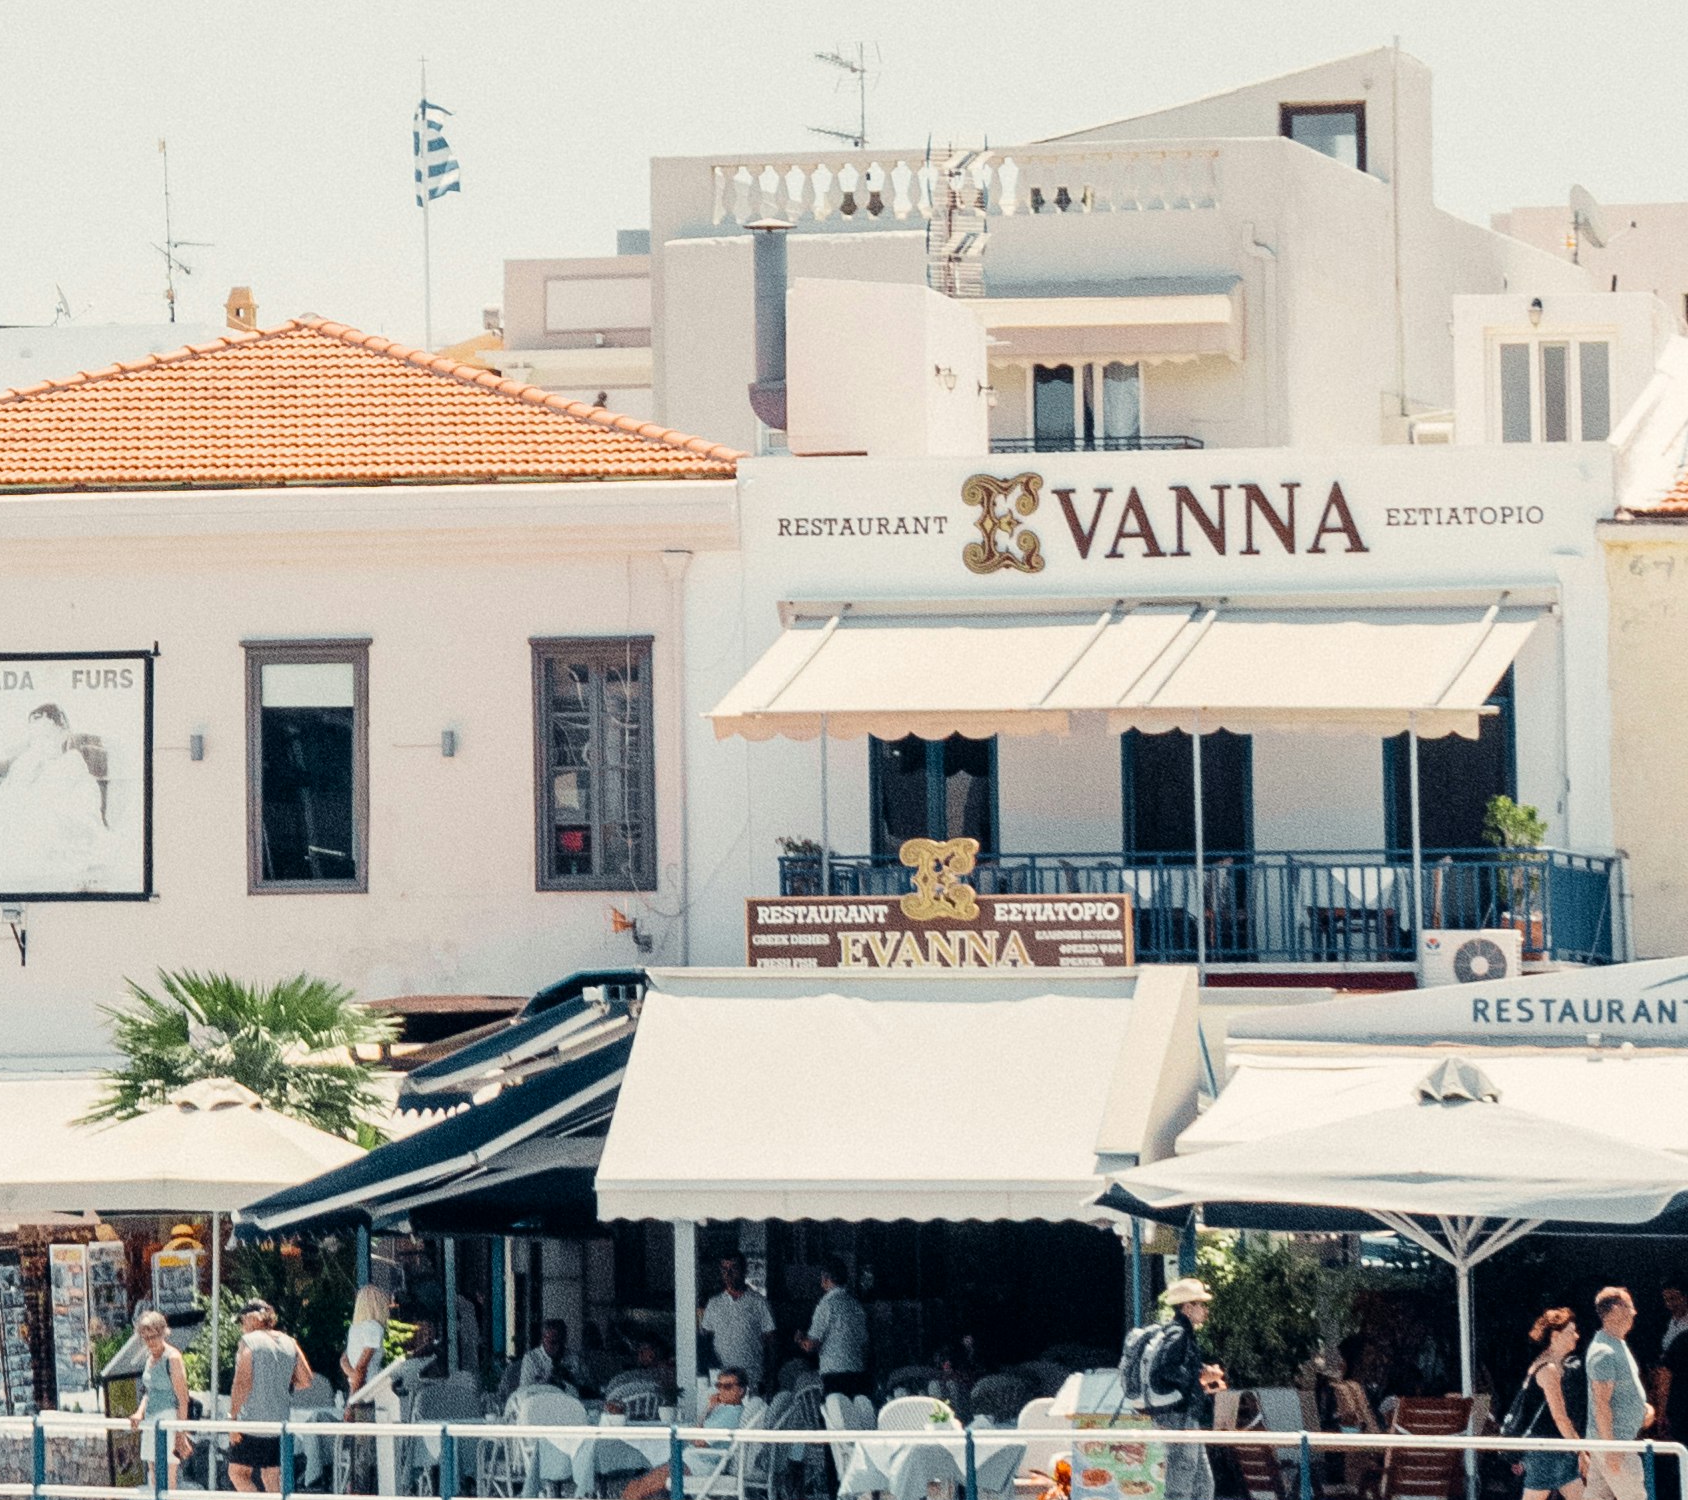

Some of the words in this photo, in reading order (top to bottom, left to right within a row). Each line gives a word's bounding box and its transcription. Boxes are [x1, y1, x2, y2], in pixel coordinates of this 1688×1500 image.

[778, 516, 948, 537] RESTAURANT
[1386, 505, 1544, 527] ΕΣΤΙΑΤΟΡΙΟ
[71, 668, 134, 689] FURS
[756, 904, 889, 925] RESTAURANT
[993, 902, 1121, 922] ΕΣΤΙΑΤΟΡΙΟ
[752, 933, 789, 946] GREEK
[790, 933, 830, 946] DISHES
[837, 929, 1035, 968] EVANNA
